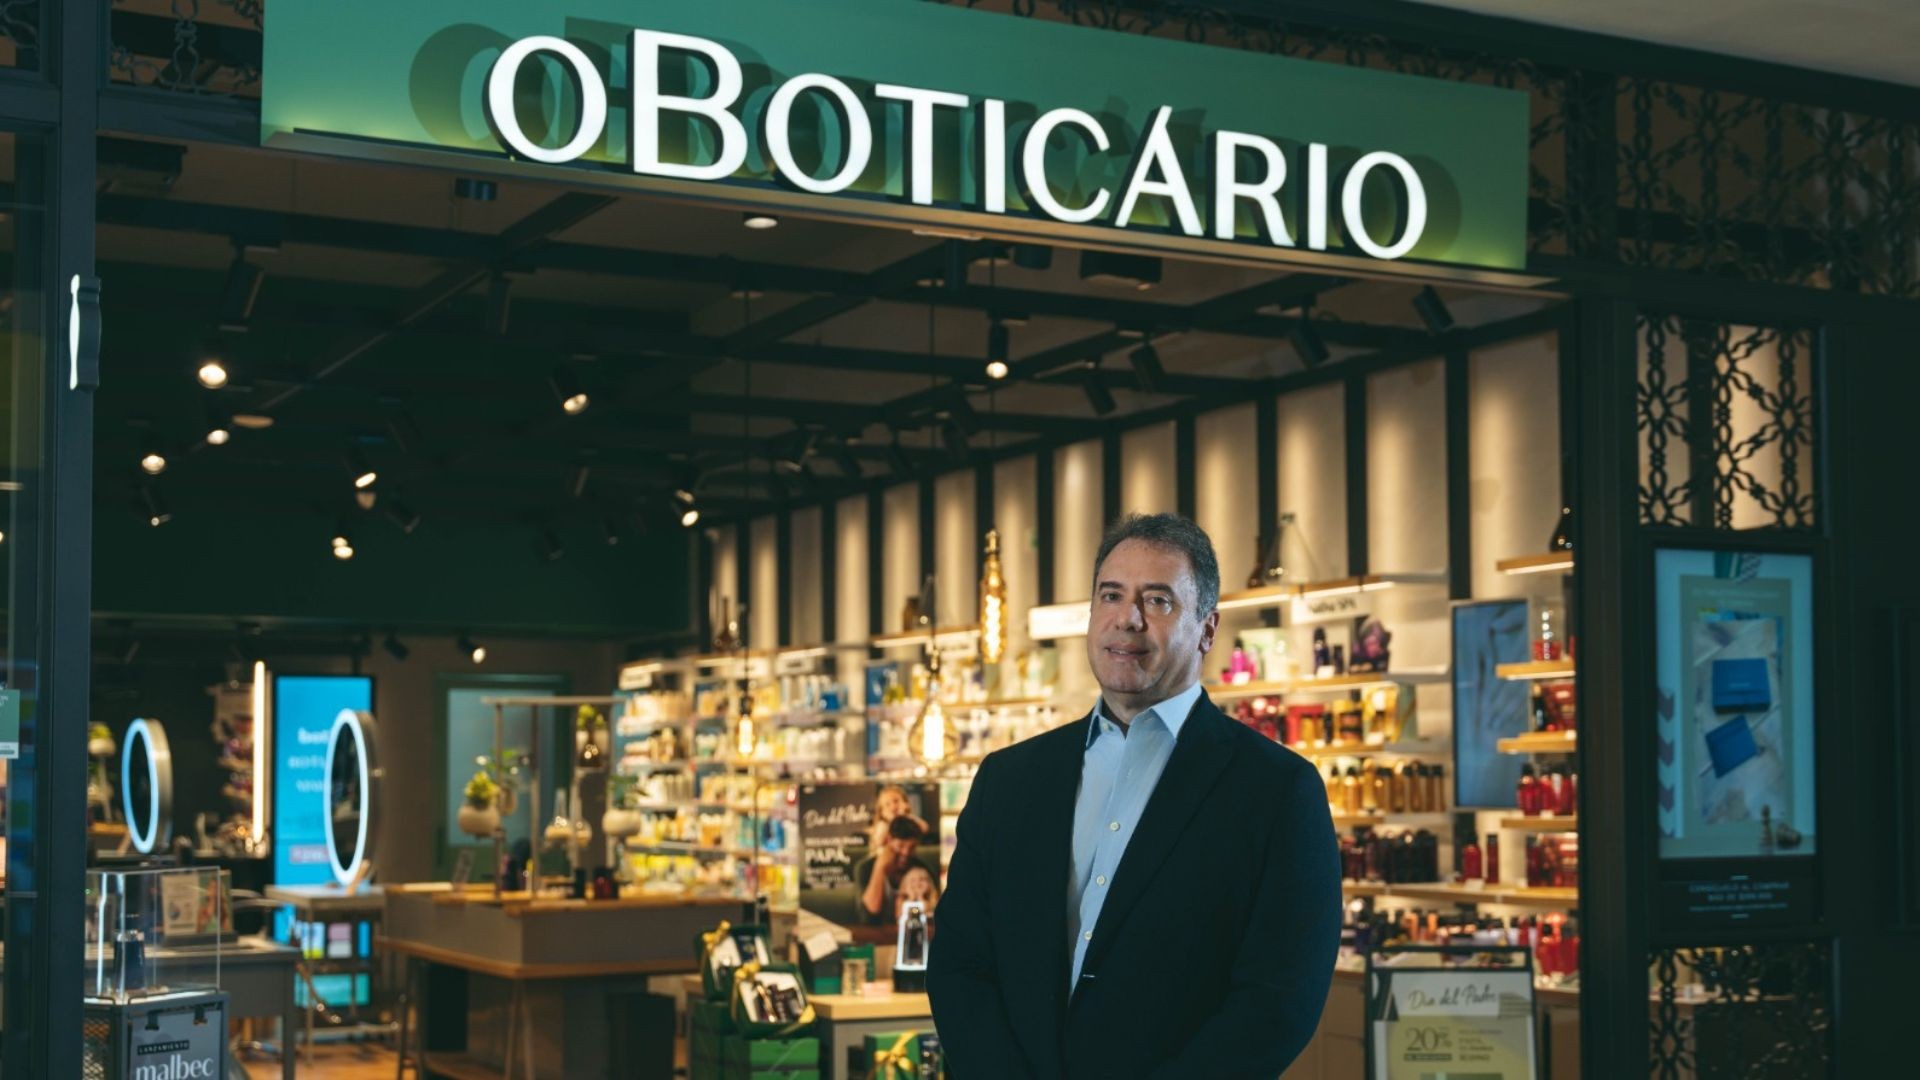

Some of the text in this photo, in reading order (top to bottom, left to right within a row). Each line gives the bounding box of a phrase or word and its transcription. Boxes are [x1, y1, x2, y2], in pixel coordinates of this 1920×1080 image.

[1439, 986, 1460, 1006] del
[1461, 983, 1497, 1006] Padre
[138, 1042, 189, 1054] LANZAMIENTO
[1405, 1026, 1453, 1052] 20%
[135, 1053, 215, 1080] malbec
